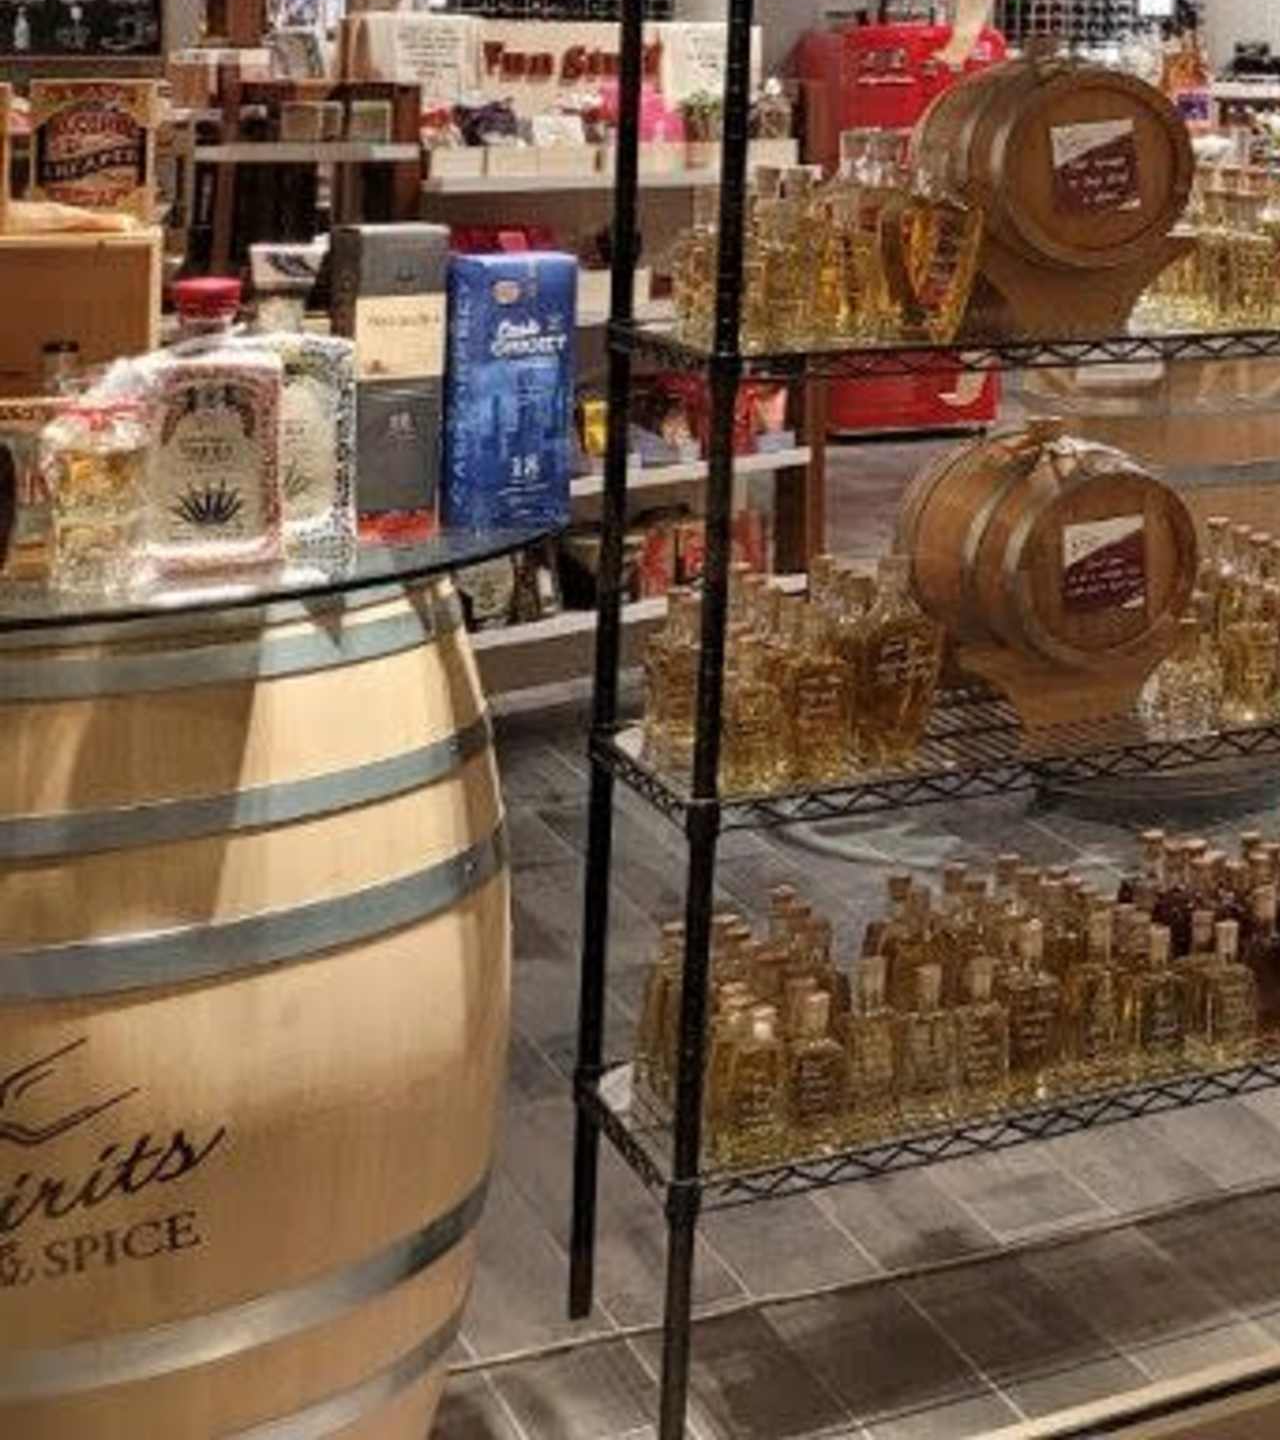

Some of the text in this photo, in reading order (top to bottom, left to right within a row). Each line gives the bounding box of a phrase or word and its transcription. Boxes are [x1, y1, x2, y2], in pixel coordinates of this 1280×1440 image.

[483, 41, 554, 77] Fun
[562, 31, 663, 80] Stuf
[42, 1209, 201, 1278] SPICE
